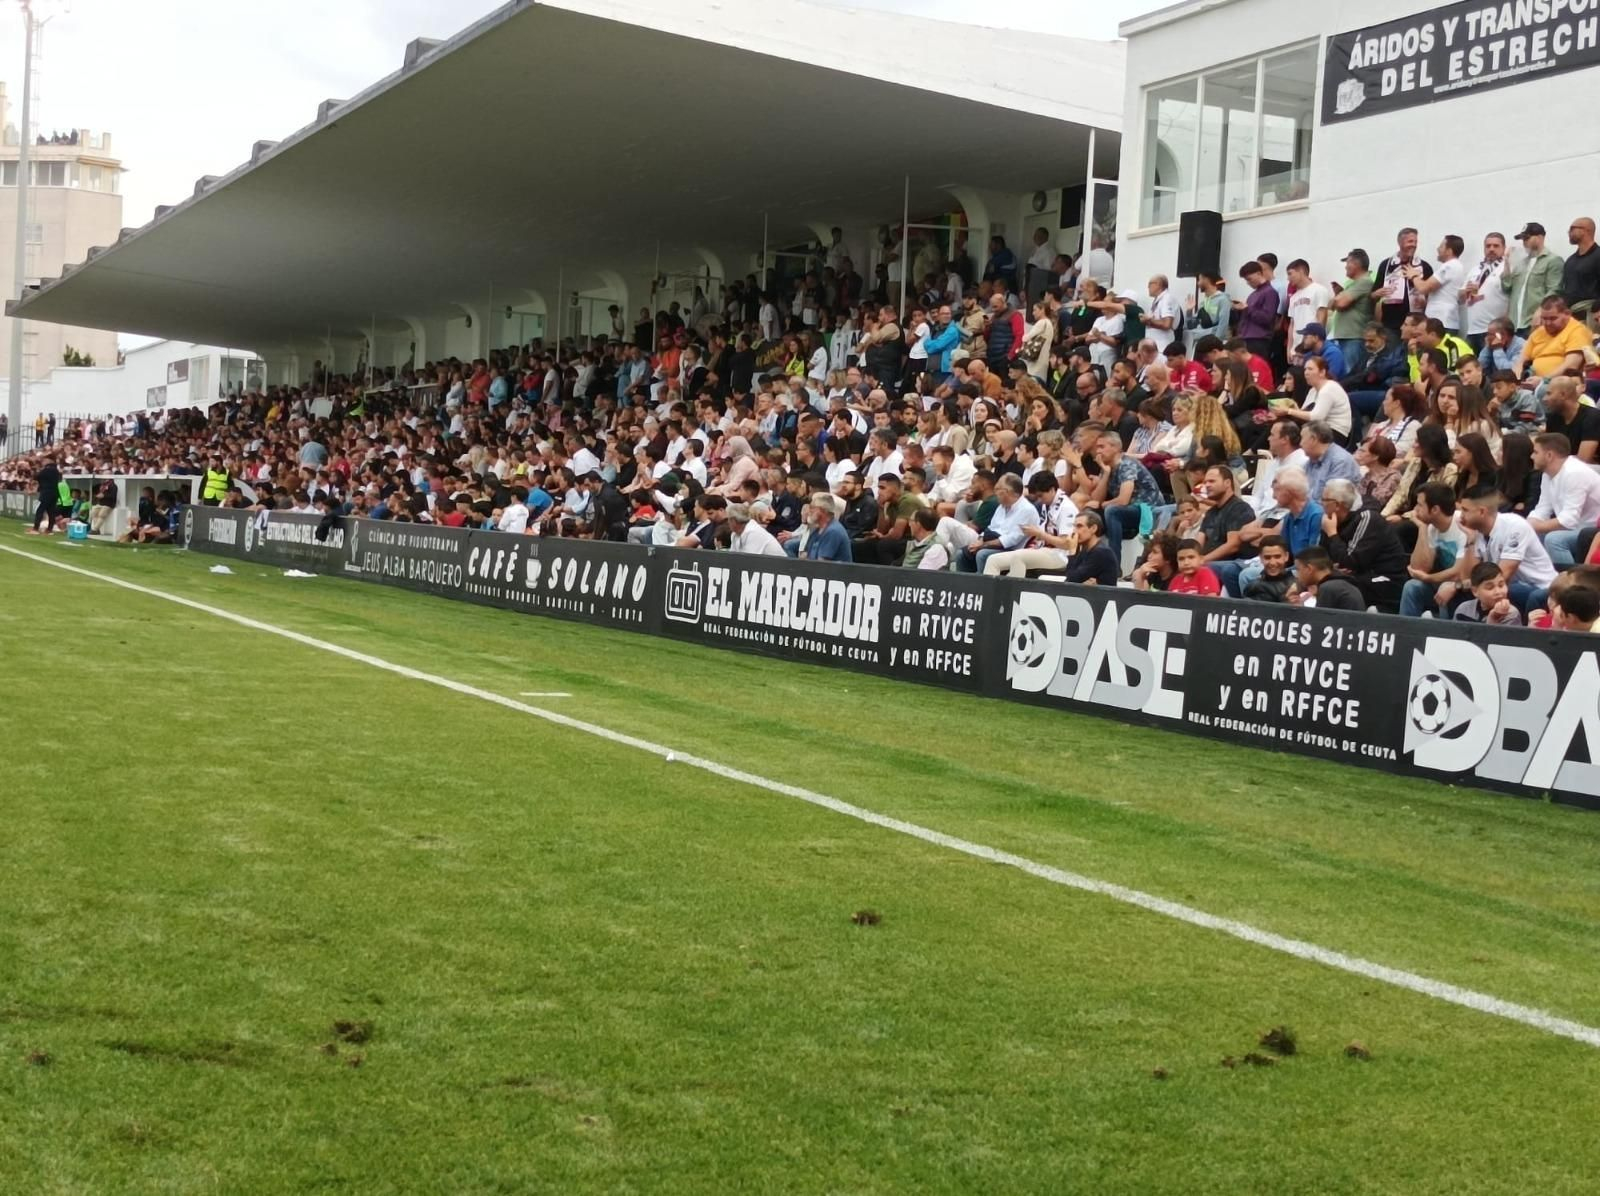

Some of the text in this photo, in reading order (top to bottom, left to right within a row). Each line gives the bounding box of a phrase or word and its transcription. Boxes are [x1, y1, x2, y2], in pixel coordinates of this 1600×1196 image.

[1348, 0, 1599, 70] ÁRIDOS Y TRANSPO
[1381, 60, 1433, 96] DEL
[368, 528, 459, 553] CLÍNICA DE FISIOTERAPIA
[383, 555, 405, 577] ALBA
[409, 558, 462, 588] BARQUERO
[468, 543, 520, 582] CAFÉ
[548, 557, 647, 602] SOLANO
[705, 566, 882, 643] EL MARCADOR
[891, 586, 983, 612] JUEVES 21:45H
[703, 622, 879, 664] REAL FEDERACIÓN DE FÚTBOL DE CEUTA
[893, 614, 975, 644] en RTVCE
[1205, 610, 1396, 656] MIÉRCOLES 21:15H
[889, 647, 972, 676] y en RFFCE
[1006, 591, 1193, 720] DBASE
[1233, 653, 1352, 692] en RTVCE
[1217, 683, 1361, 729] y en RFFCE
[1188, 711, 1397, 761] REAL FEDERACIÓN DE FÚTBOL DE CEUTA
